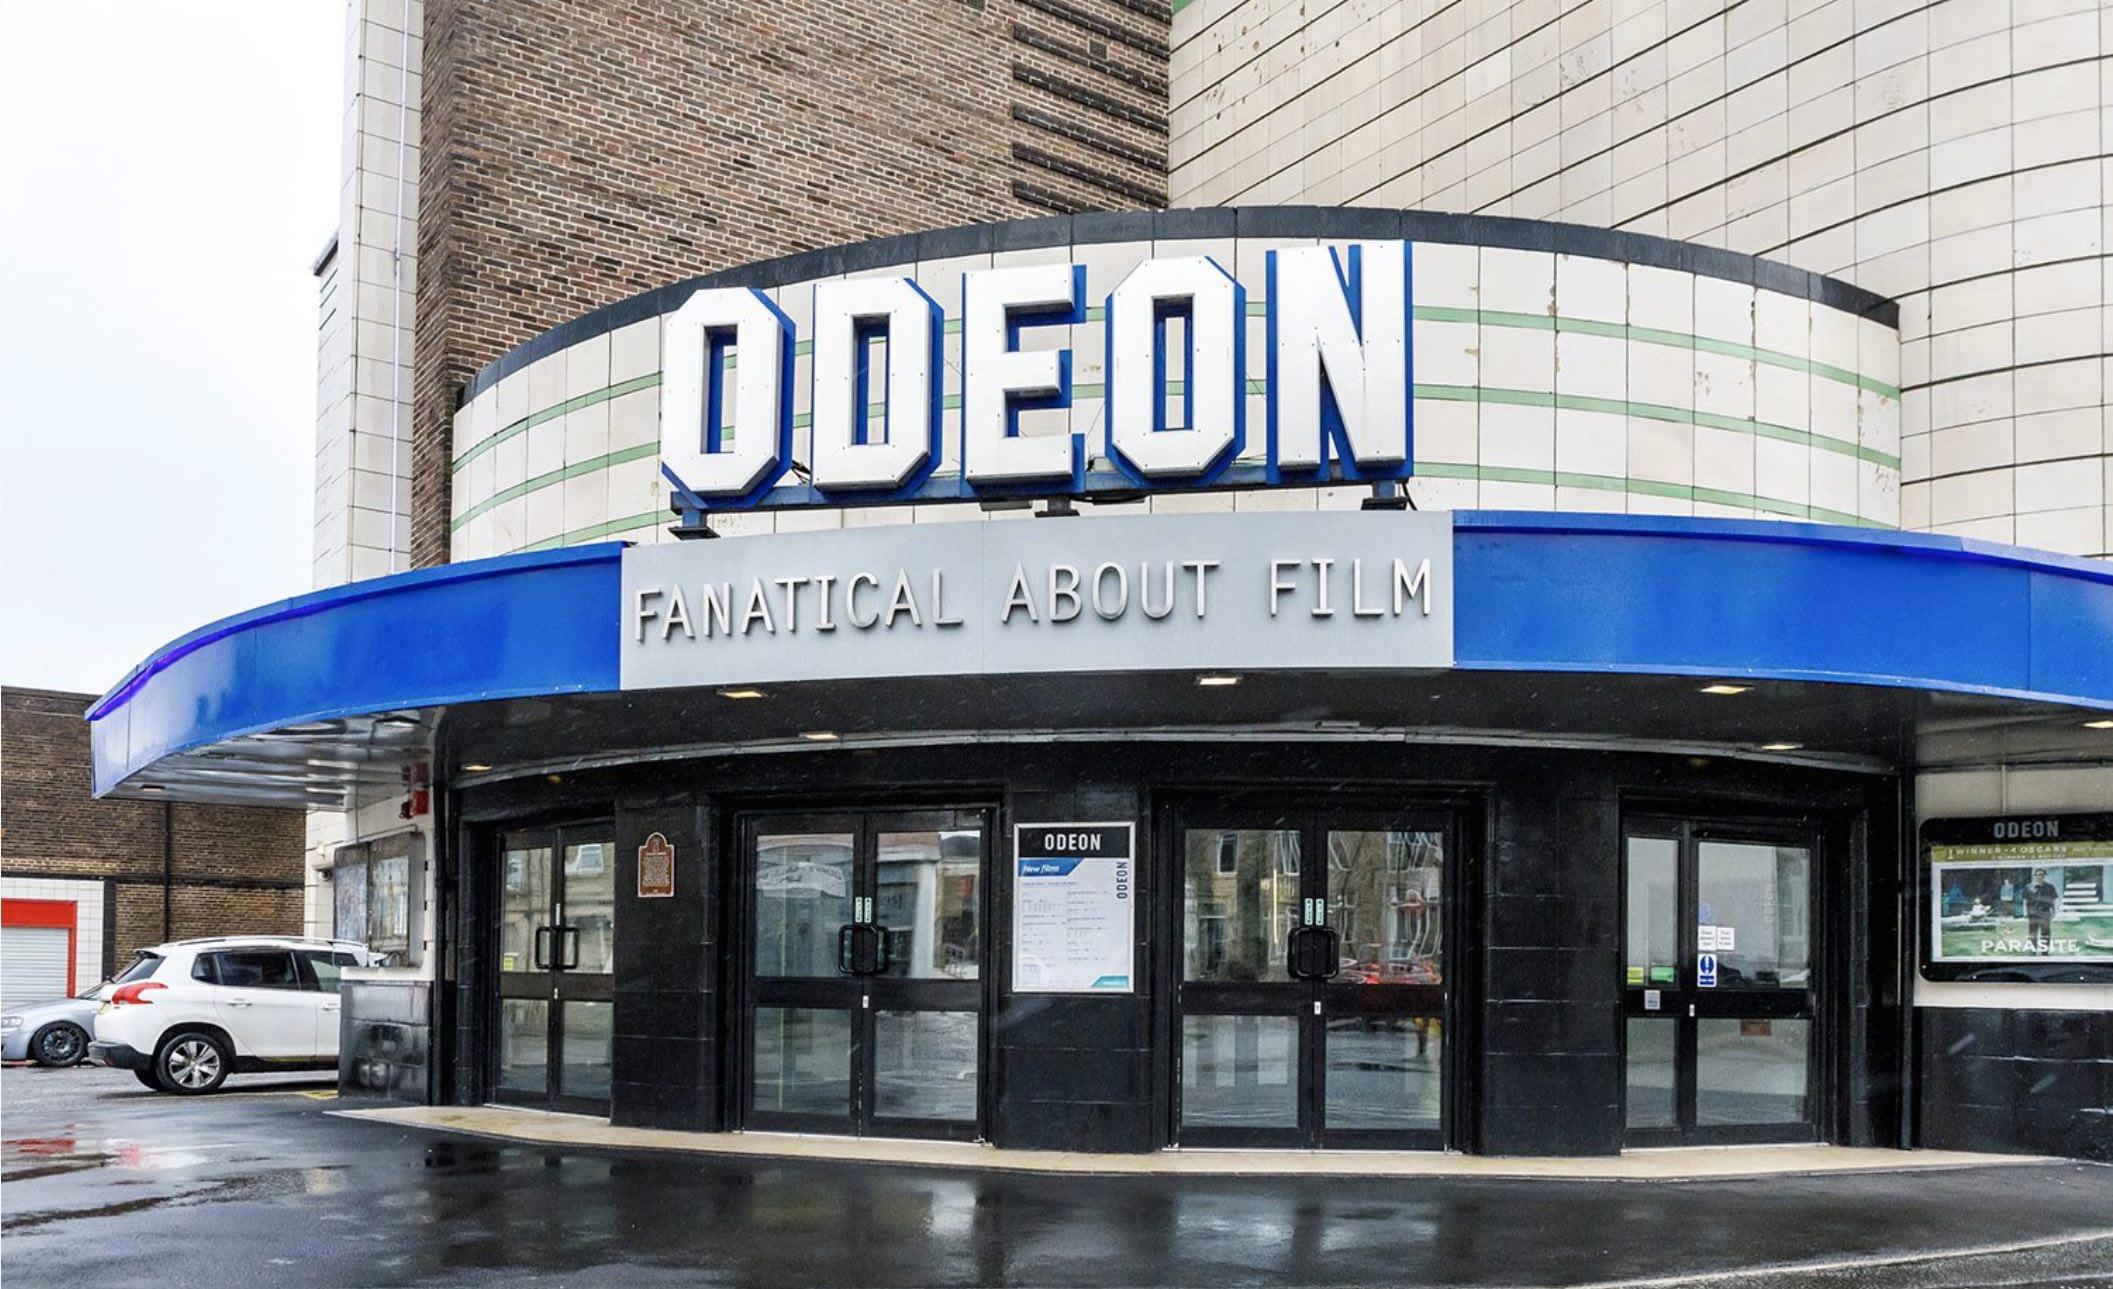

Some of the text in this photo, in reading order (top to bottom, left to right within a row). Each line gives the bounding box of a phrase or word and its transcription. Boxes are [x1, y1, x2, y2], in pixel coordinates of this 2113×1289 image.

[661, 239, 1414, 504] ODEON
[634, 557, 1432, 643] FANATICAL ABOUT FILM
[1993, 820, 2059, 839] ODEON
[1044, 833, 1102, 851] ODEON
[1956, 846, 2001, 855] WINNER
[2020, 844, 2067, 854] OSCARS
[1116, 861, 1128, 899] ODEON
[1981, 939, 2080, 953] PARASITE
